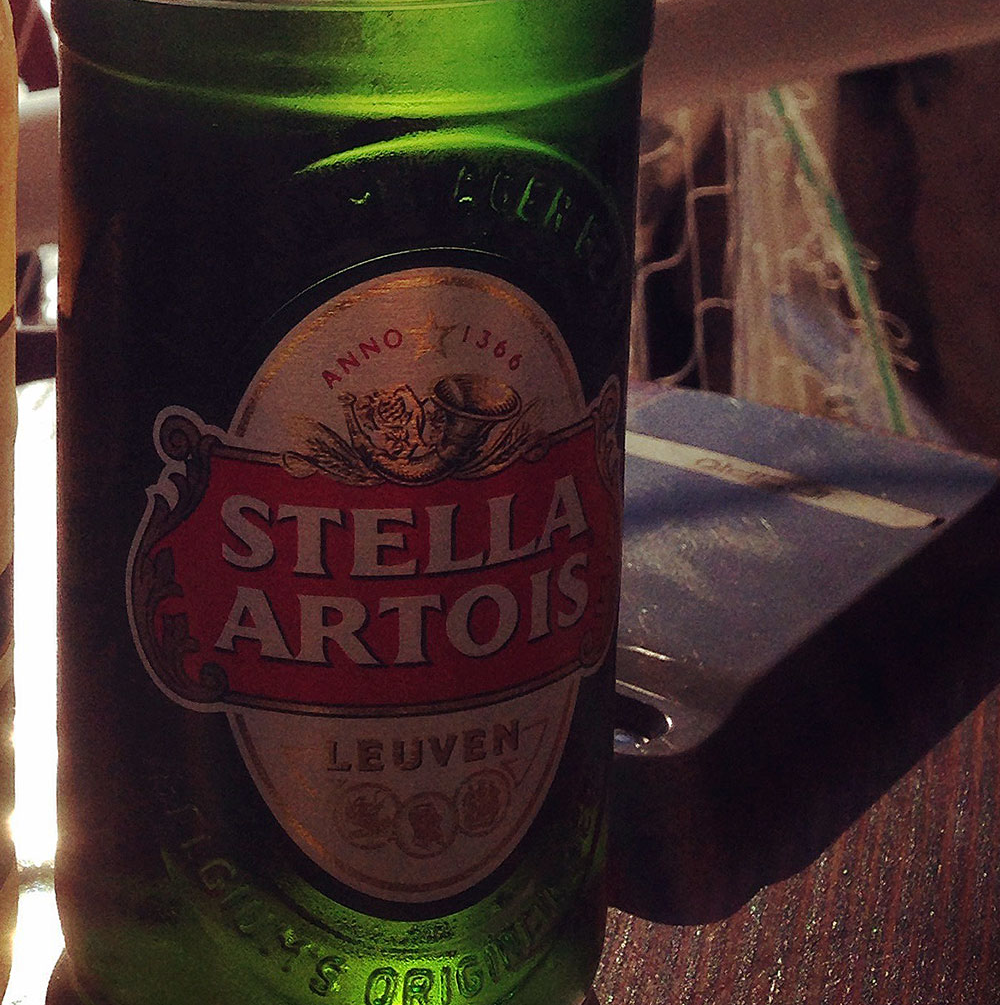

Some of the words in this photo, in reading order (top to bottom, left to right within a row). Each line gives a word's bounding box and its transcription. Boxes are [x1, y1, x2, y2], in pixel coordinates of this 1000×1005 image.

[320, 329, 403, 391] ANNO
[463, 325, 522, 372] 1366
[220, 475, 592, 577] STELLA
[214, 552, 591, 666] ARTOIS
[326, 722, 522, 773] LEUVEN
